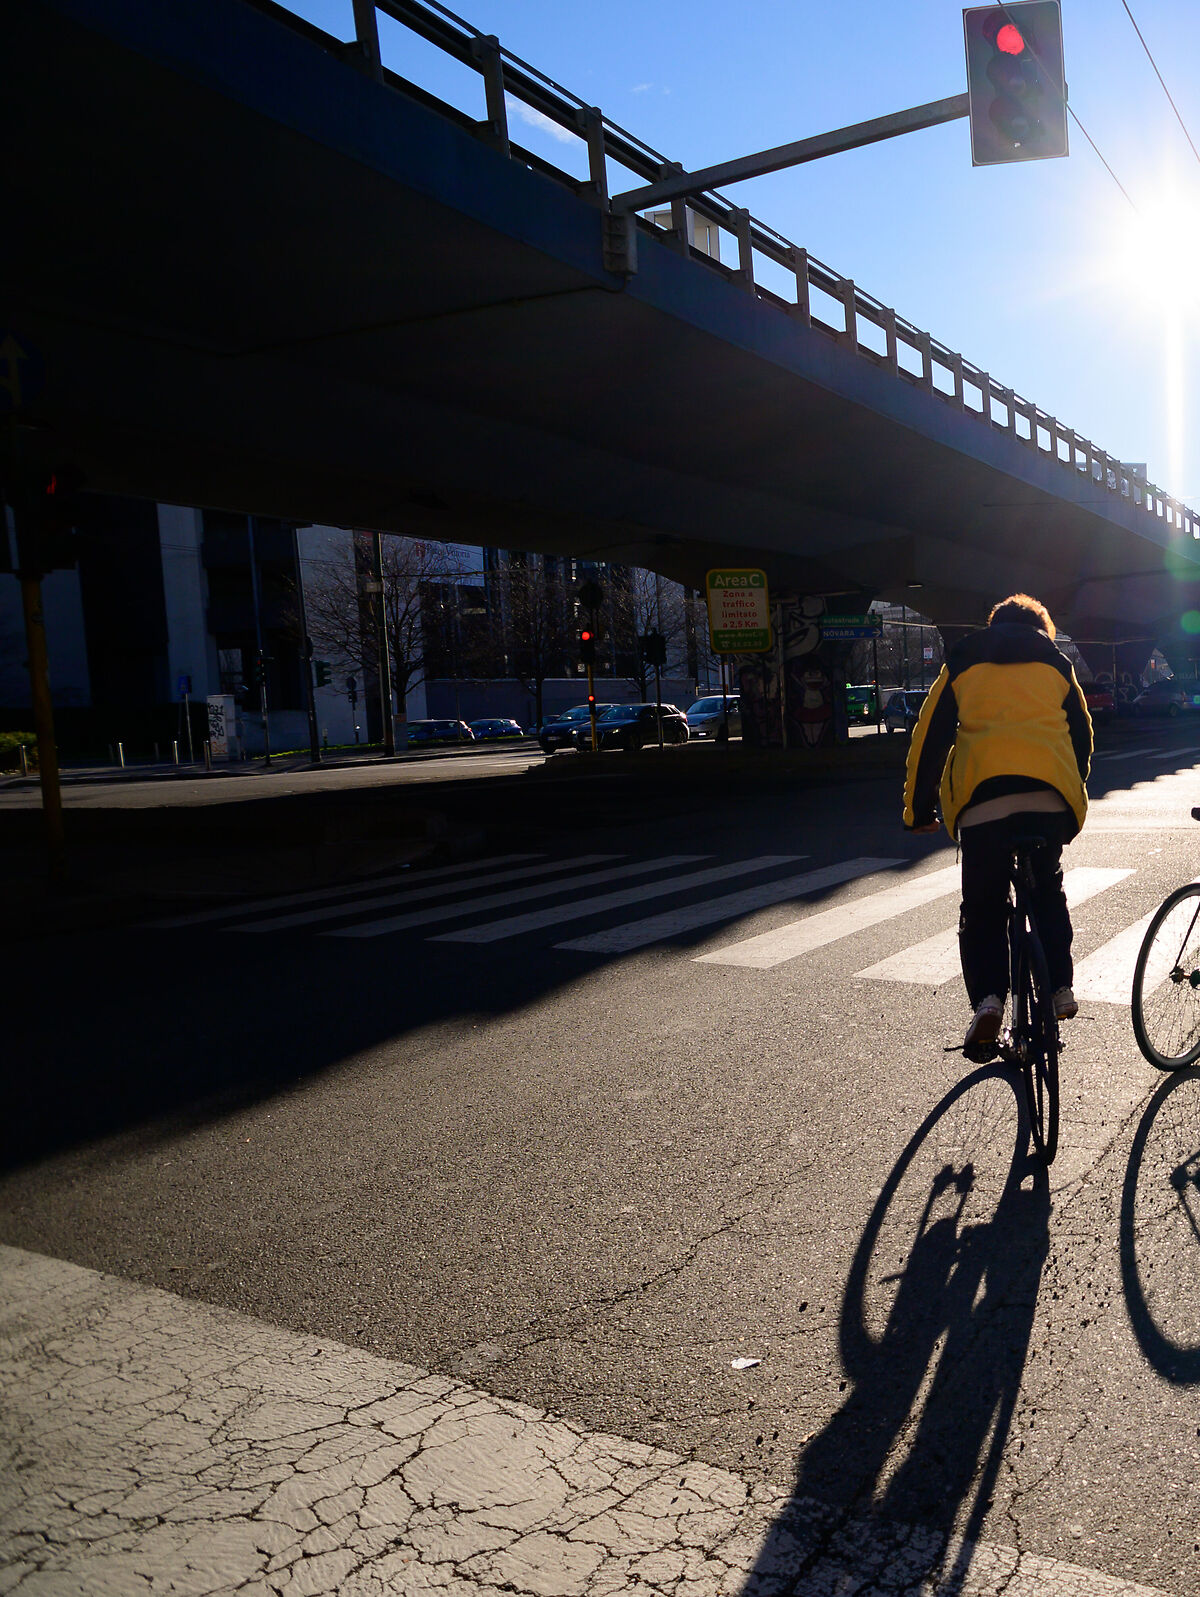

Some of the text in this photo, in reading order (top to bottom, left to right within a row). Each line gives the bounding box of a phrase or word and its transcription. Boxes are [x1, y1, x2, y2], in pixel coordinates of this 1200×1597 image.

[722, 600, 756, 608] traffico
[722, 610, 757, 618] limitato
[823, 630, 855, 638] NOVARA
